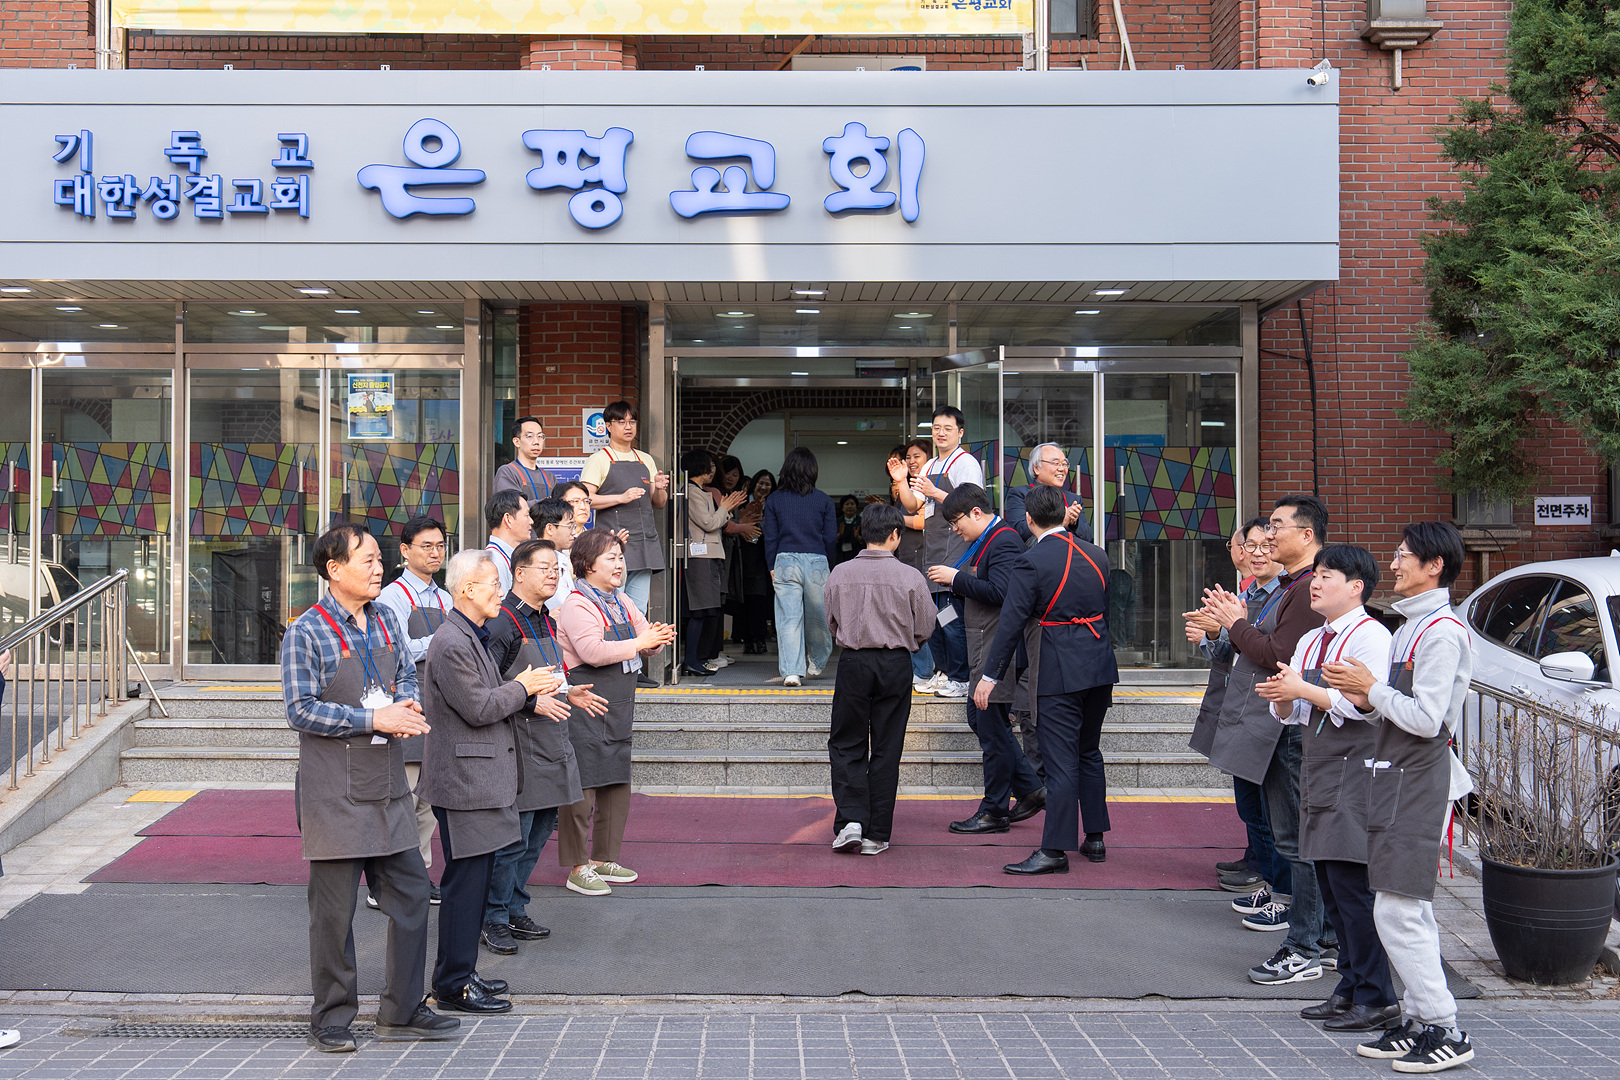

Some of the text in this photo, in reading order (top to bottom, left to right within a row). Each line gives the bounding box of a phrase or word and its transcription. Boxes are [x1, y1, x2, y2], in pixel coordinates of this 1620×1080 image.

[357, 118, 925, 229] 은평교회
[53, 174, 311, 219] 대한성결교회
[352, 381, 369, 389] 신천지
[1536, 503, 1590, 519] 전면주차
